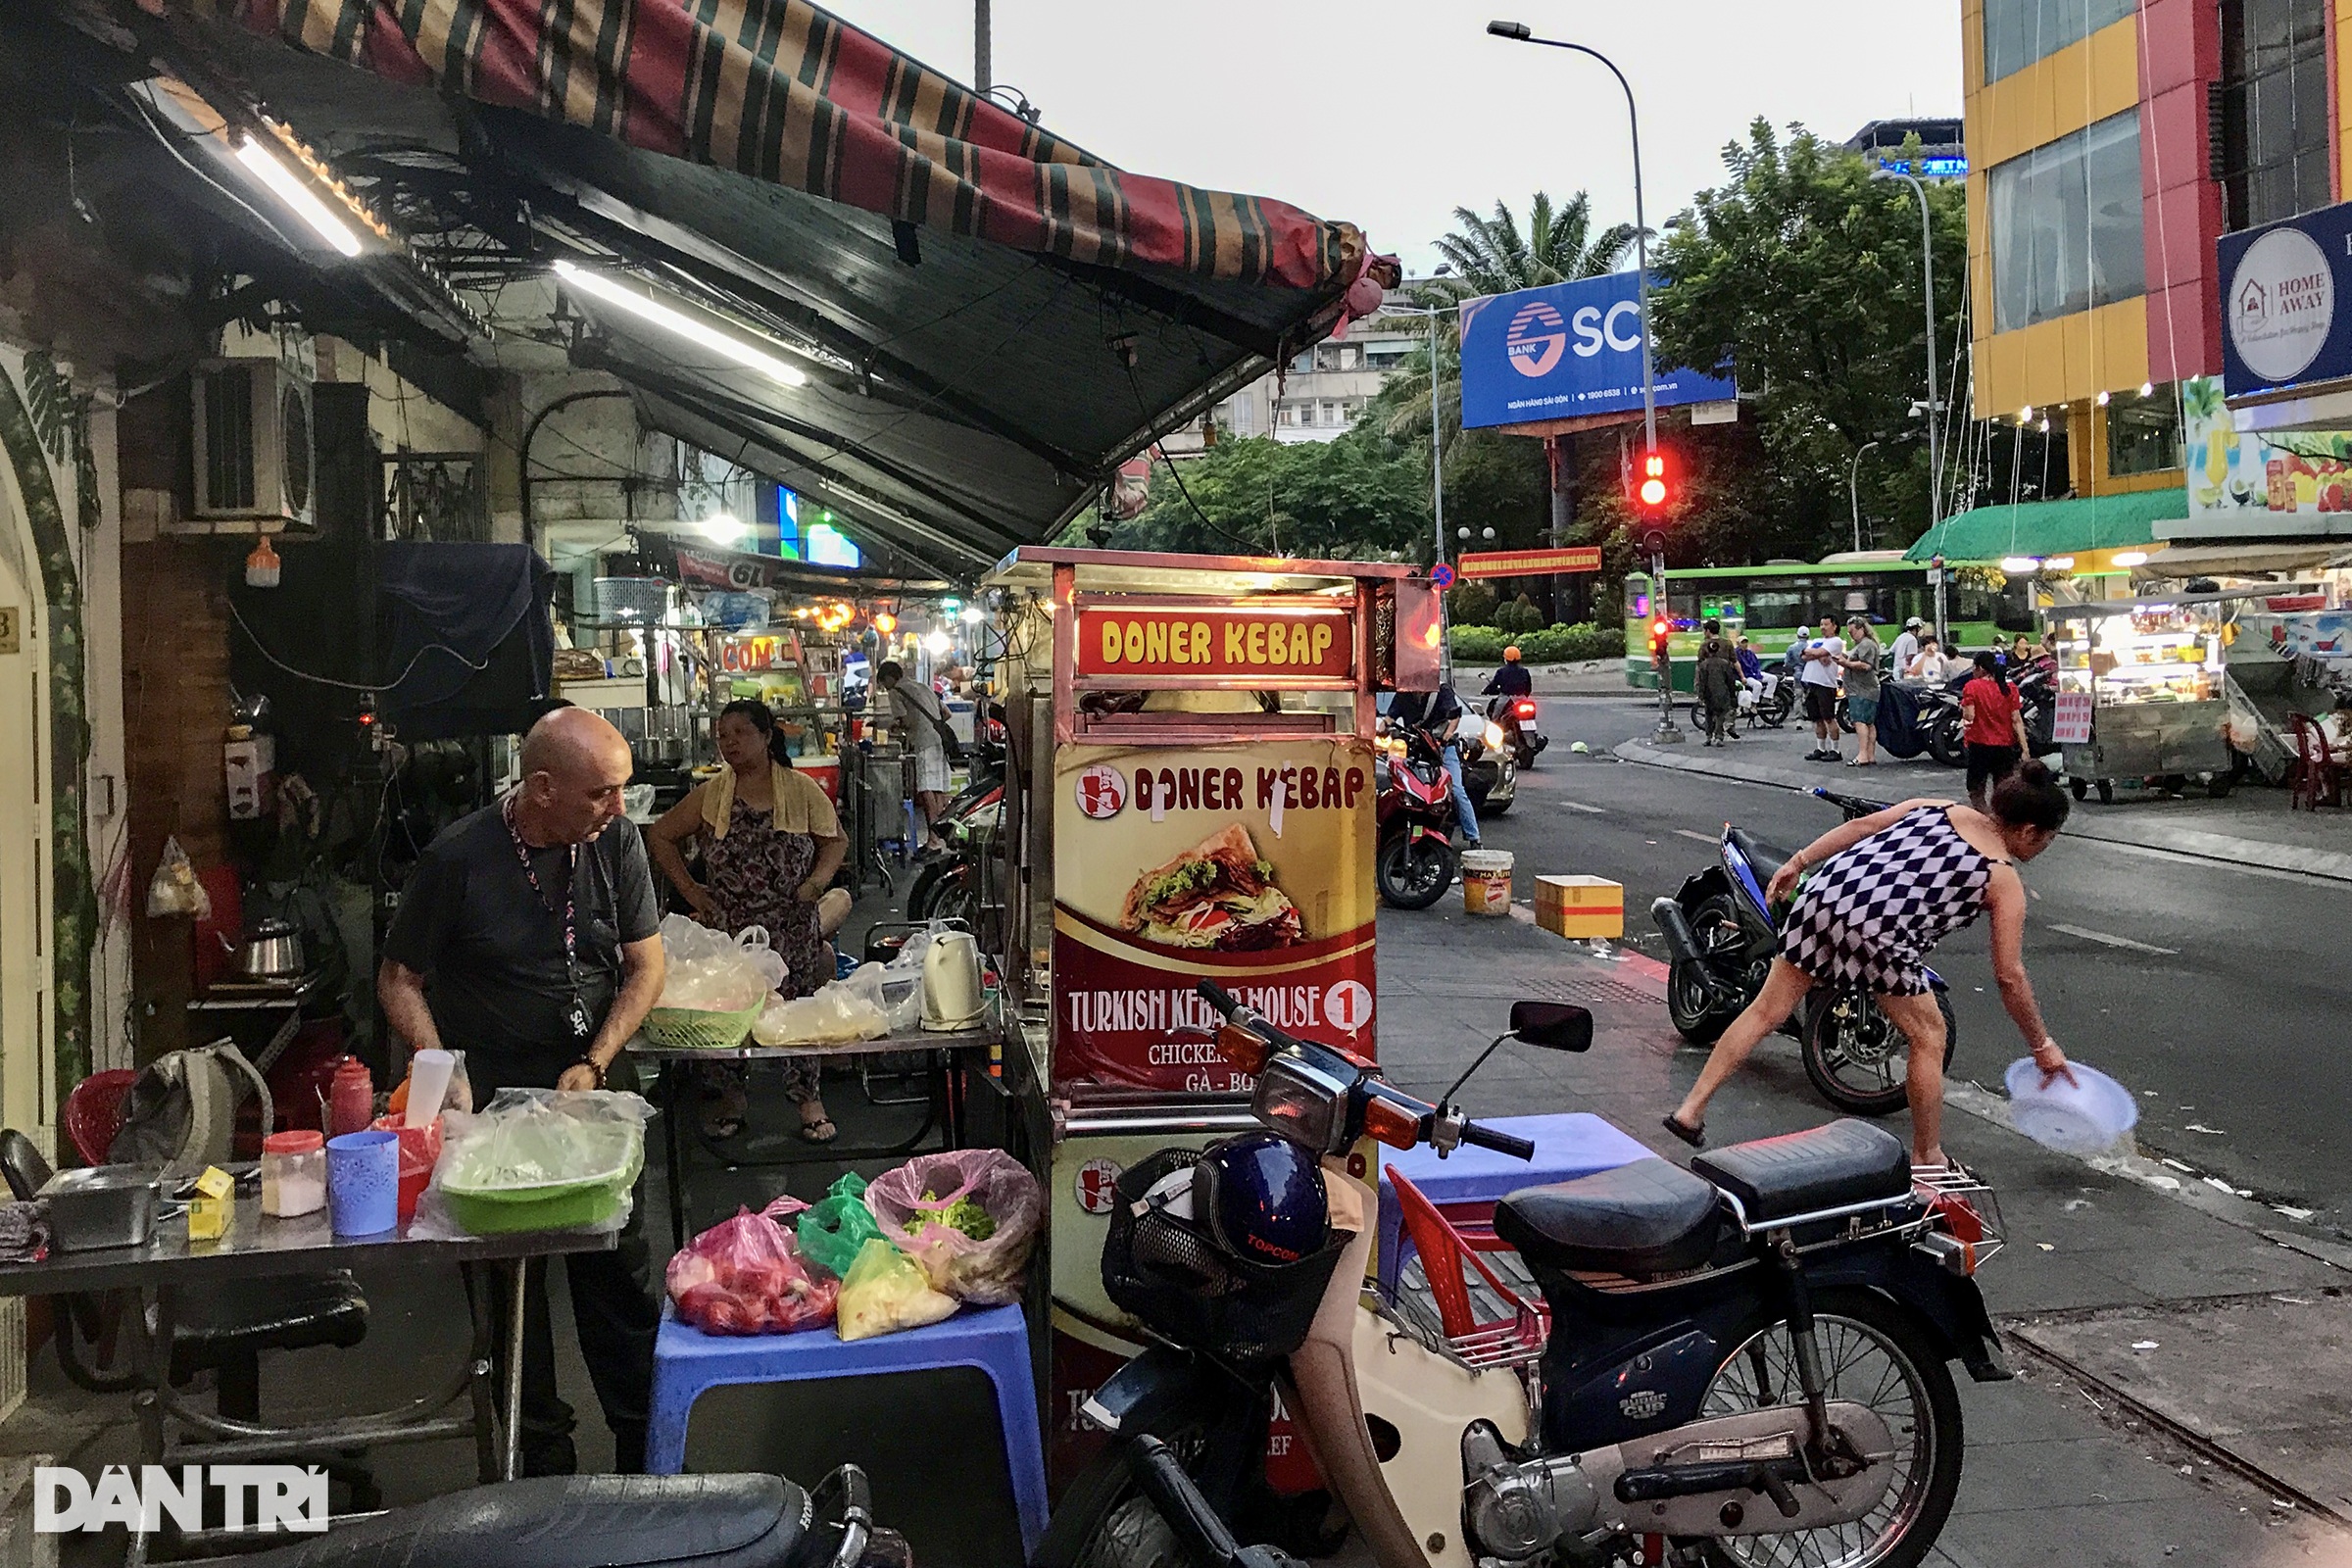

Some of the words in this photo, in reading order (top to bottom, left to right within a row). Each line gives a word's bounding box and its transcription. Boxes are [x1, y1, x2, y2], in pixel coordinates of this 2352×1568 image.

[2278, 272, 2326, 297] HOME
[2279, 291, 2325, 316] AWAY
[1508, 343, 1536, 356] BANK
[1588, 390, 1602, 400] 1900
[1102, 620, 1212, 664] DONER
[1224, 621, 1334, 665] KEBAP
[1135, 767, 1243, 810] DONER
[1257, 766, 1364, 810] KEBAP
[1068, 988, 1166, 1032] TURKISH
[1337, 987, 1353, 1023] 1
[1186, 1066, 1211, 1092] GÀ
